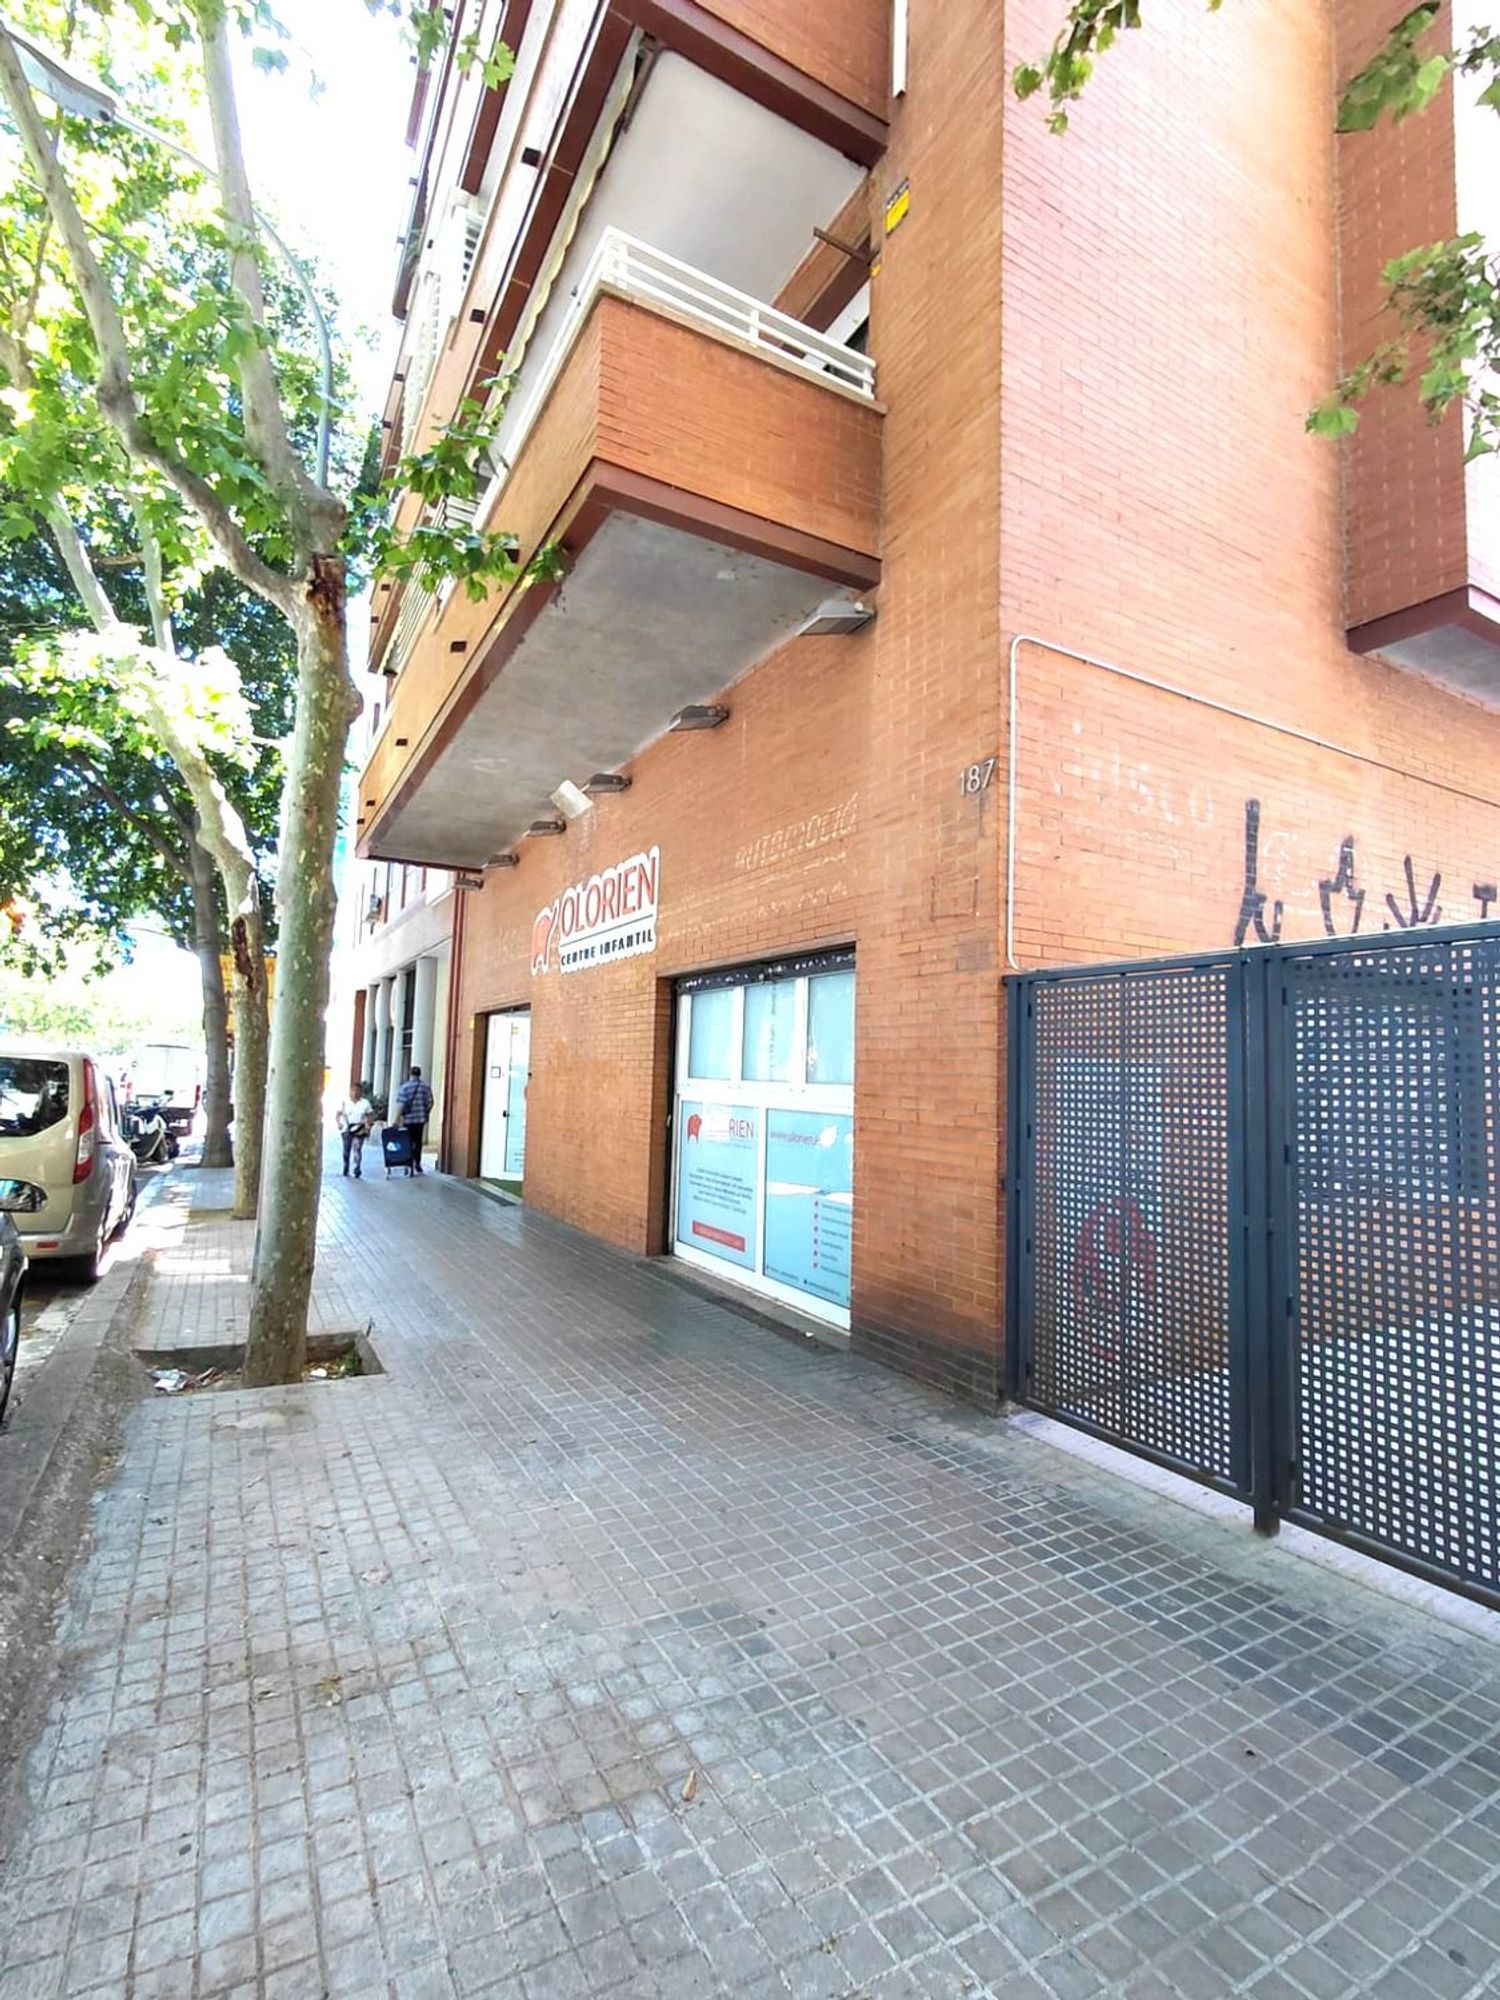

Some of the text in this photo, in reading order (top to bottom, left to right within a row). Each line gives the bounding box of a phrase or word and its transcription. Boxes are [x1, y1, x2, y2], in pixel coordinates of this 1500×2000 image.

[960, 757, 995, 797] 187
[561, 929, 653, 966] CENTRE INFANTIL
